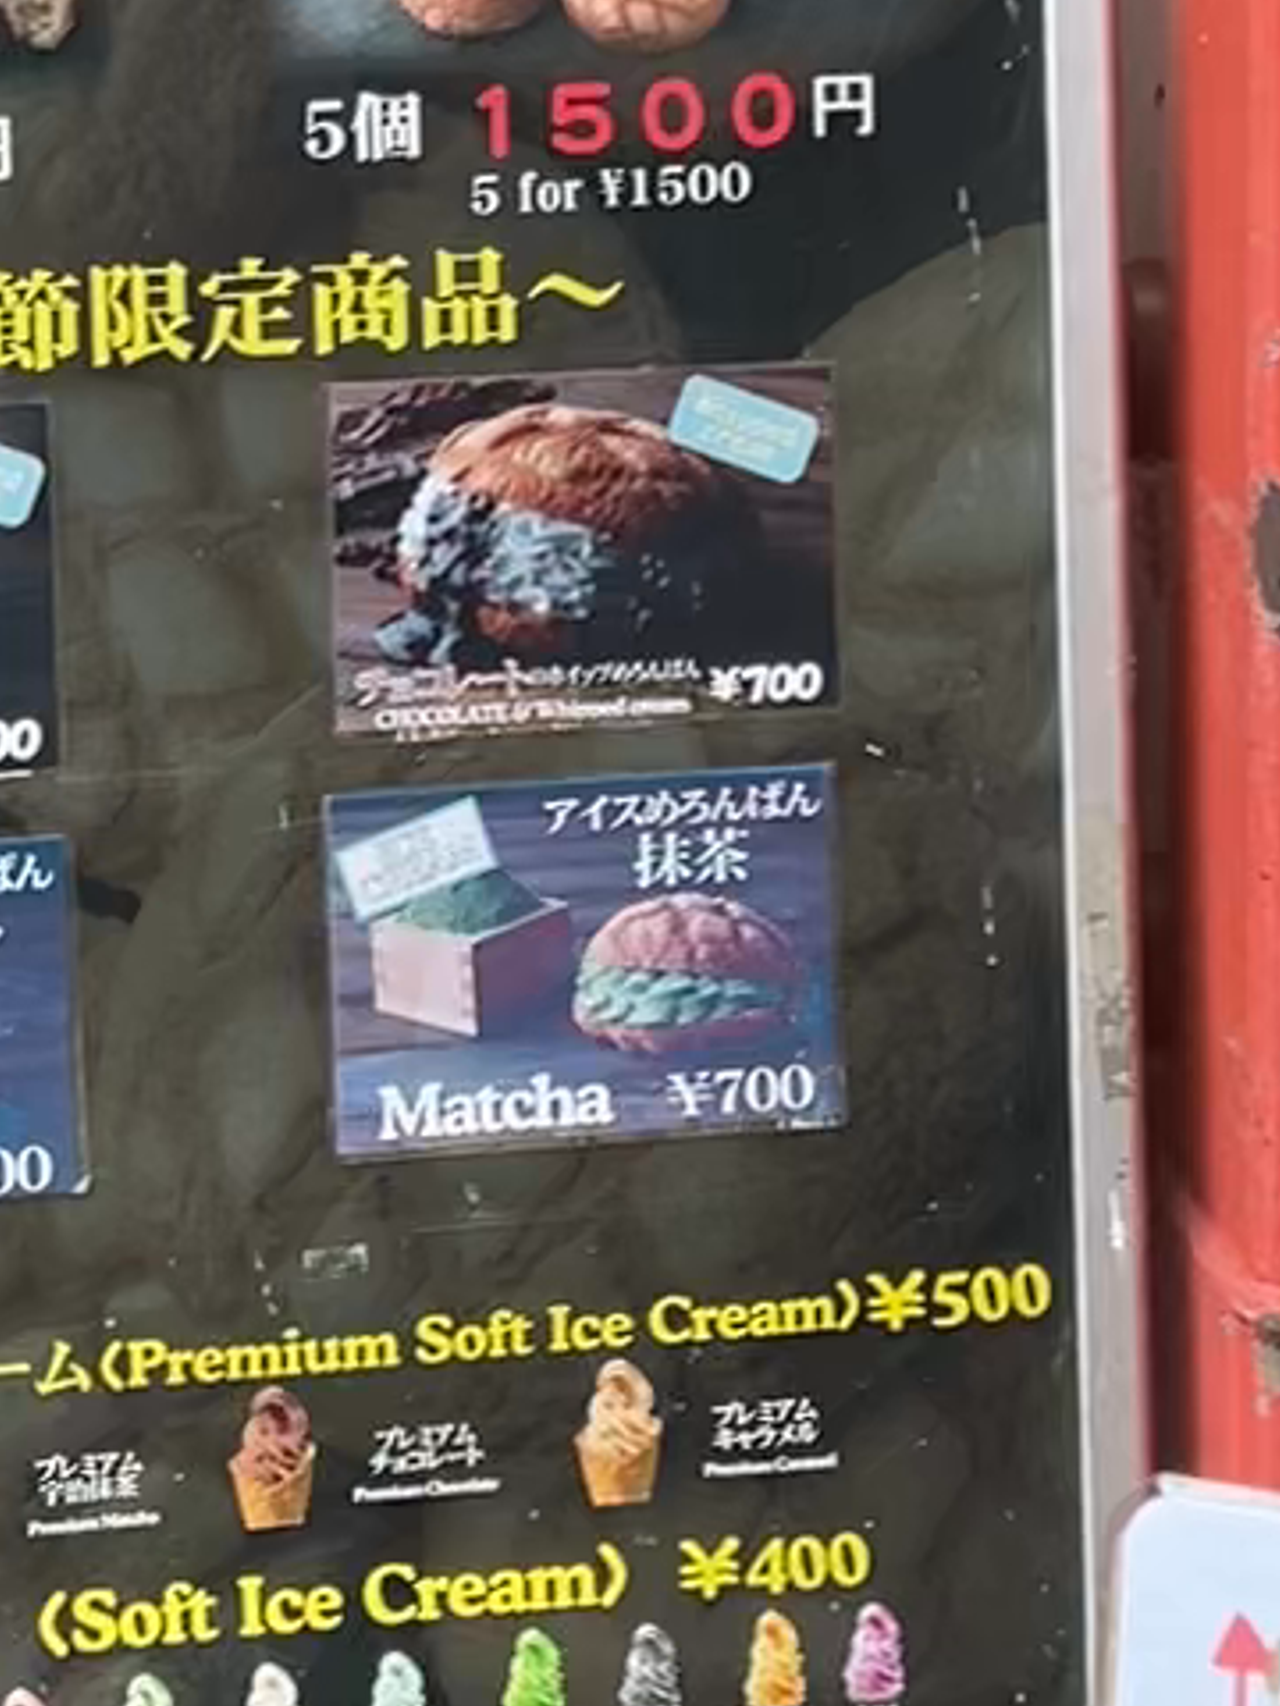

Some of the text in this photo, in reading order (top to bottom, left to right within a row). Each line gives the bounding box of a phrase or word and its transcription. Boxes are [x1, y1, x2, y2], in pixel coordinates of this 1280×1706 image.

[303, 89, 422, 163] 5個
[470, 161, 753, 216] 5 for ¥1500
[708, 661, 824, 704] ¥700
[633, 829, 750, 887] 抹茶
[377, 1065, 814, 1141] Matcha ¥700
[414, 1310, 534, 1364] Soft
[547, 1303, 634, 1354] Ice
[236, 1576, 345, 1637] Ice
[678, 1531, 871, 1599] ¥400
